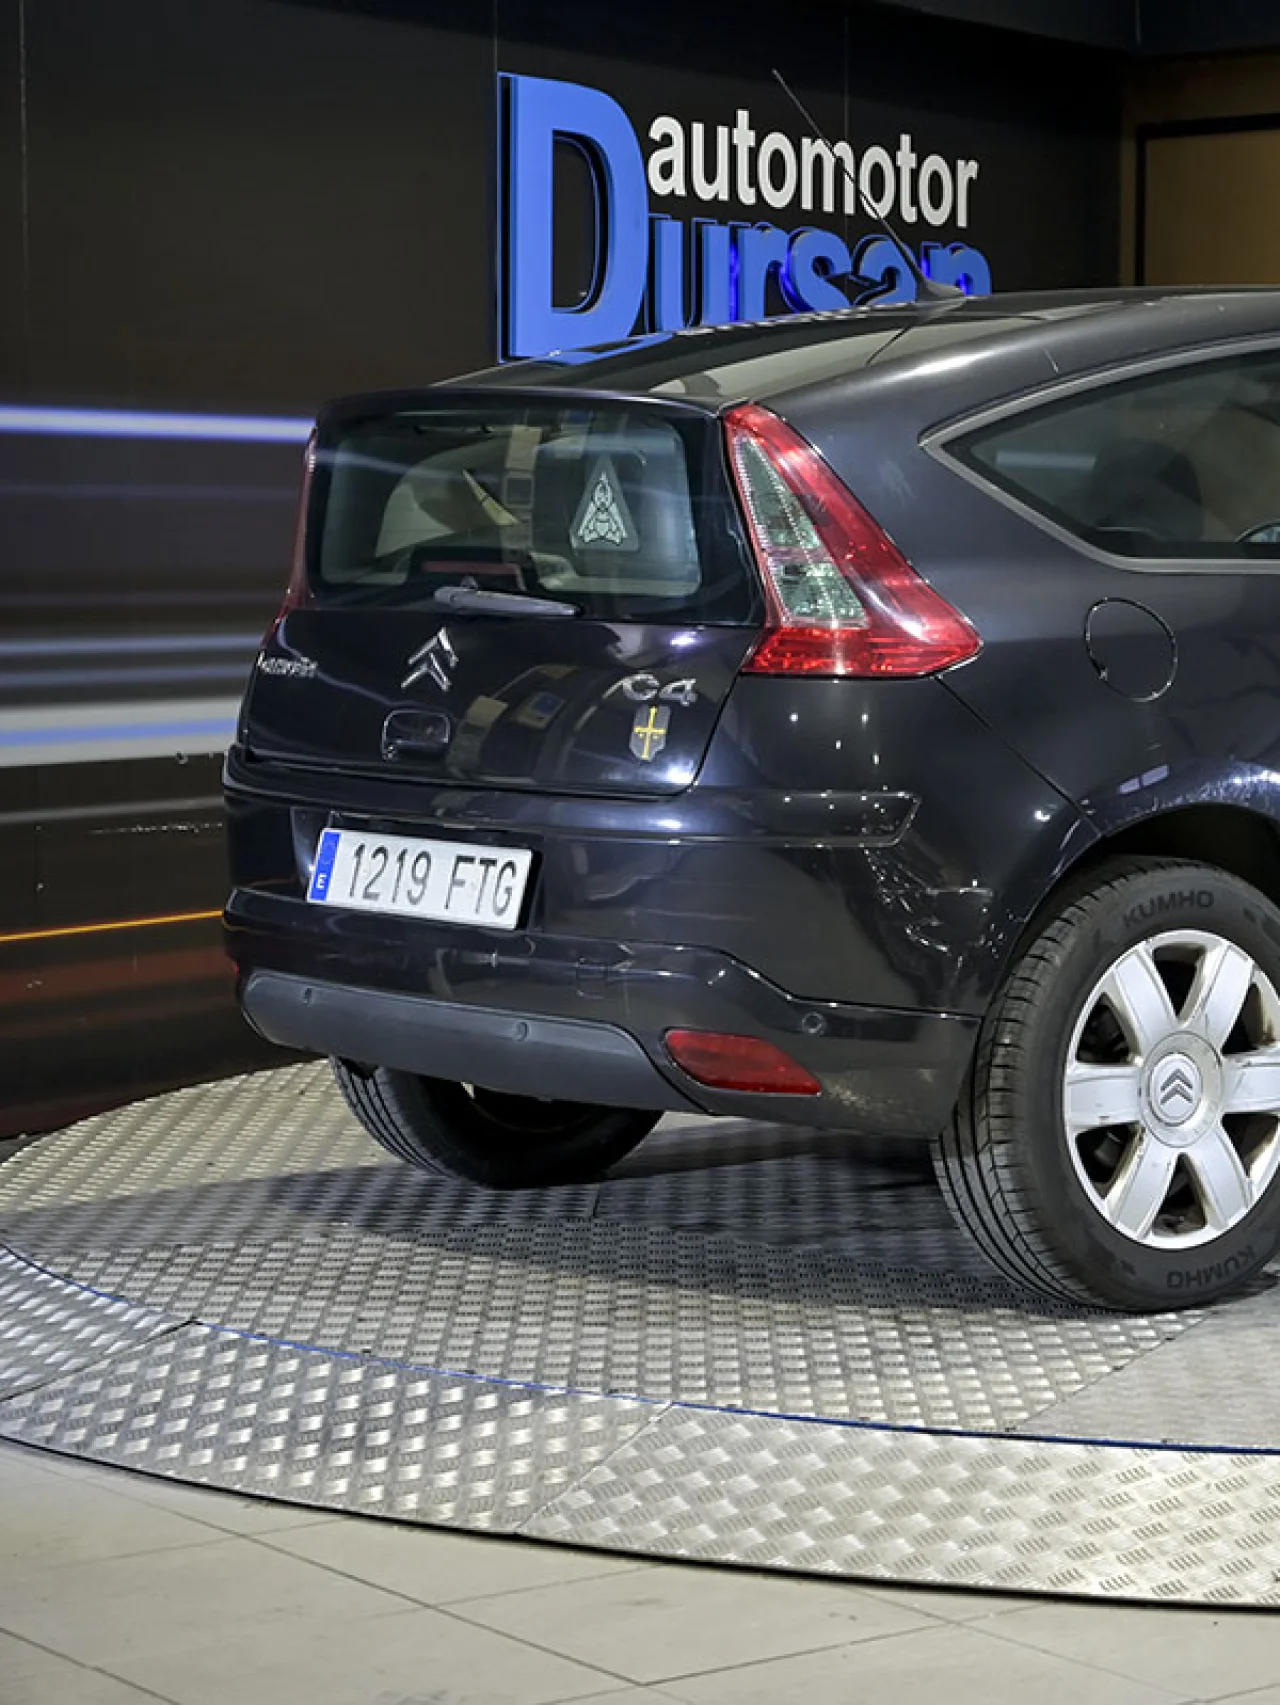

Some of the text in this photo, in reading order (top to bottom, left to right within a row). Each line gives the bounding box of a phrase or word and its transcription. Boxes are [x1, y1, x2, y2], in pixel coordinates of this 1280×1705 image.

[647, 108, 979, 229] automotor
[316, 873, 326, 890] E
[349, 842, 517, 917] 1219 FTG
[1121, 889, 1214, 928] KUMHO
[1166, 1244, 1257, 1290] KUMHO
